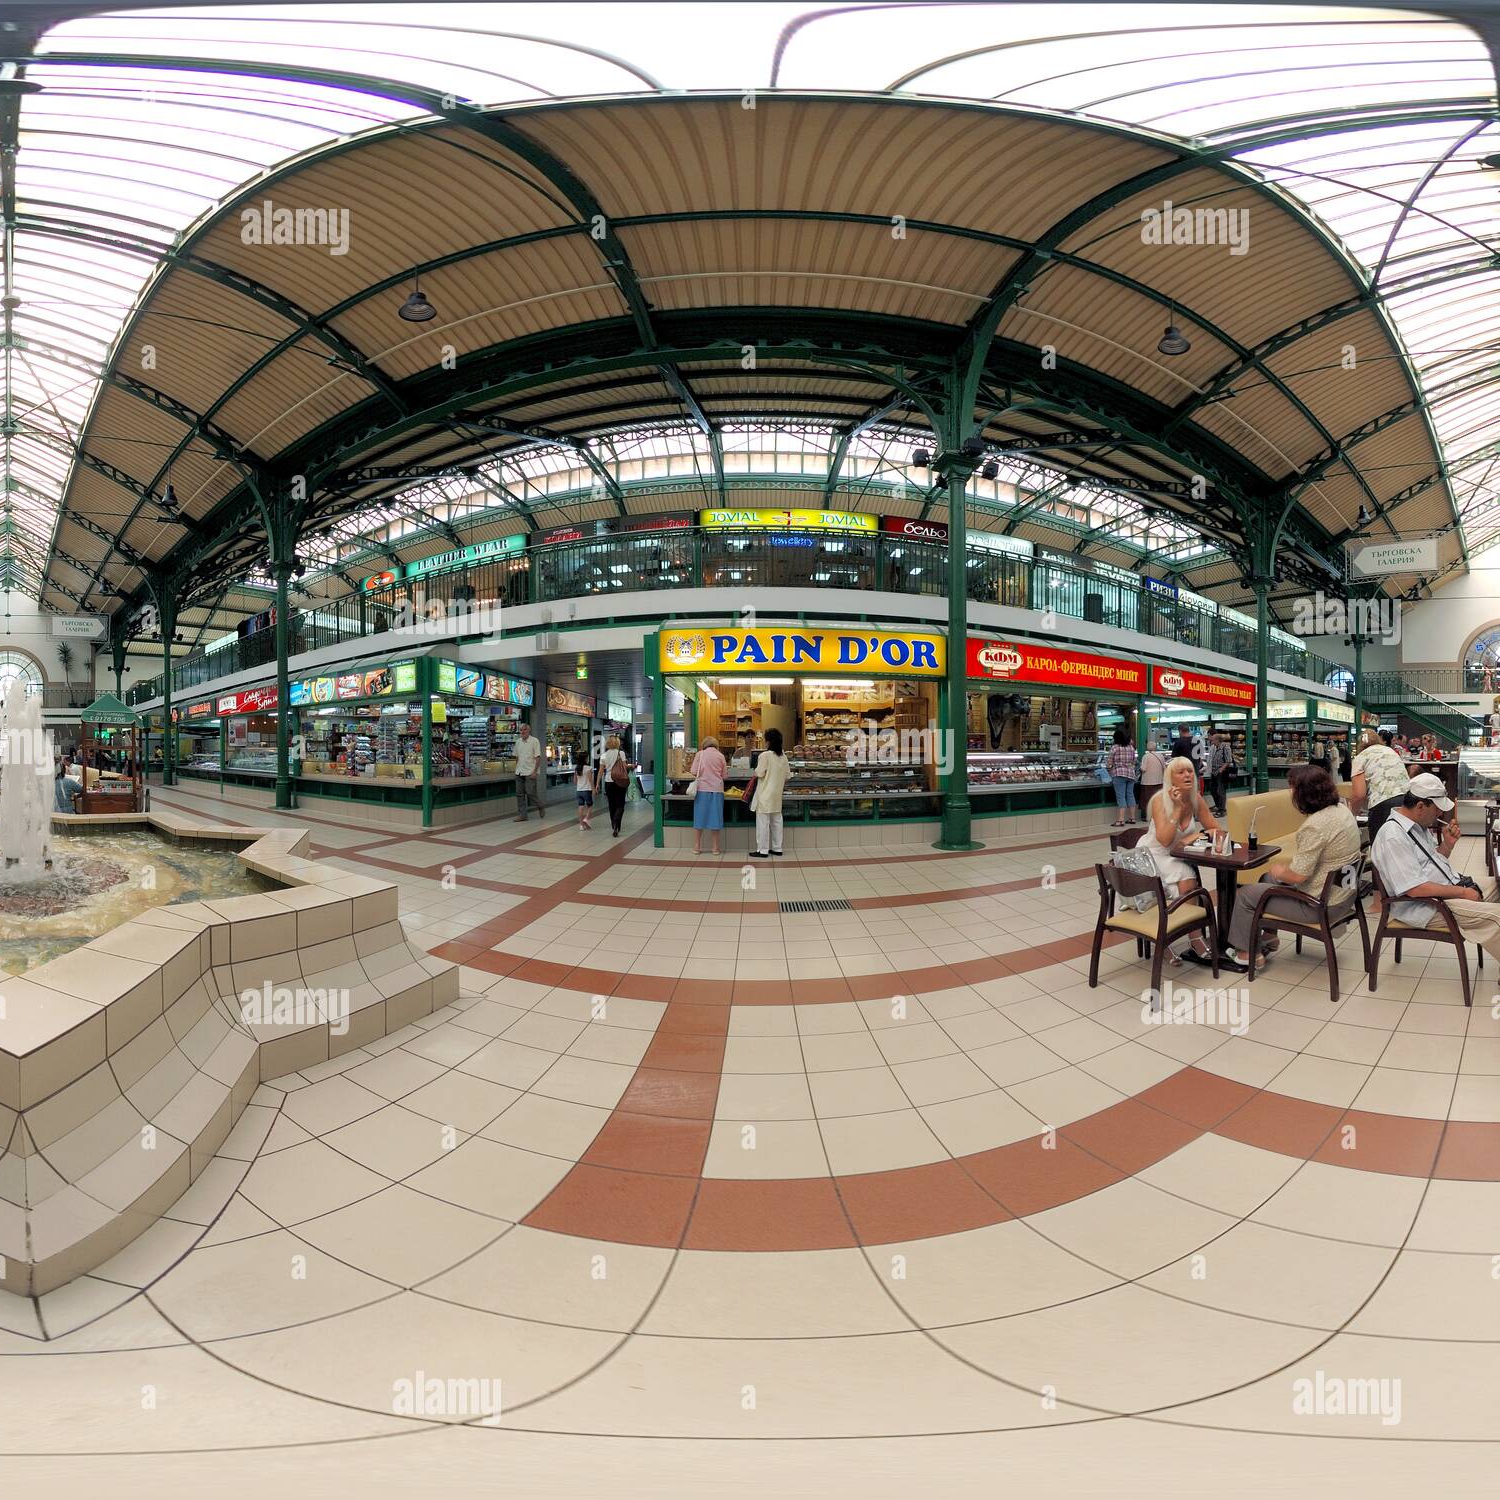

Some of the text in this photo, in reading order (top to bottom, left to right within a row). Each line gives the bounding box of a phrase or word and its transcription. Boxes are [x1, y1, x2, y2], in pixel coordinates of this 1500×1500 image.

[708, 511, 760, 523] JOVIAL
[819, 513, 868, 527] JOVIAL
[903, 521, 947, 539] бельо
[417, 539, 509, 571] LEATHER WEAR
[1371, 547, 1422, 558] ТЪРГОВСКА
[1377, 557, 1415, 566] ГАЛЕРИЯ
[1150, 580, 1175, 597] РИЗИ
[711, 634, 940, 668] PAIN D'OR
[1026, 656, 1115, 680] КАРОЛ-ФЕРНАНДЕС
[1187, 680, 1252, 700] KAROL-FERNANDEZ MEAT
